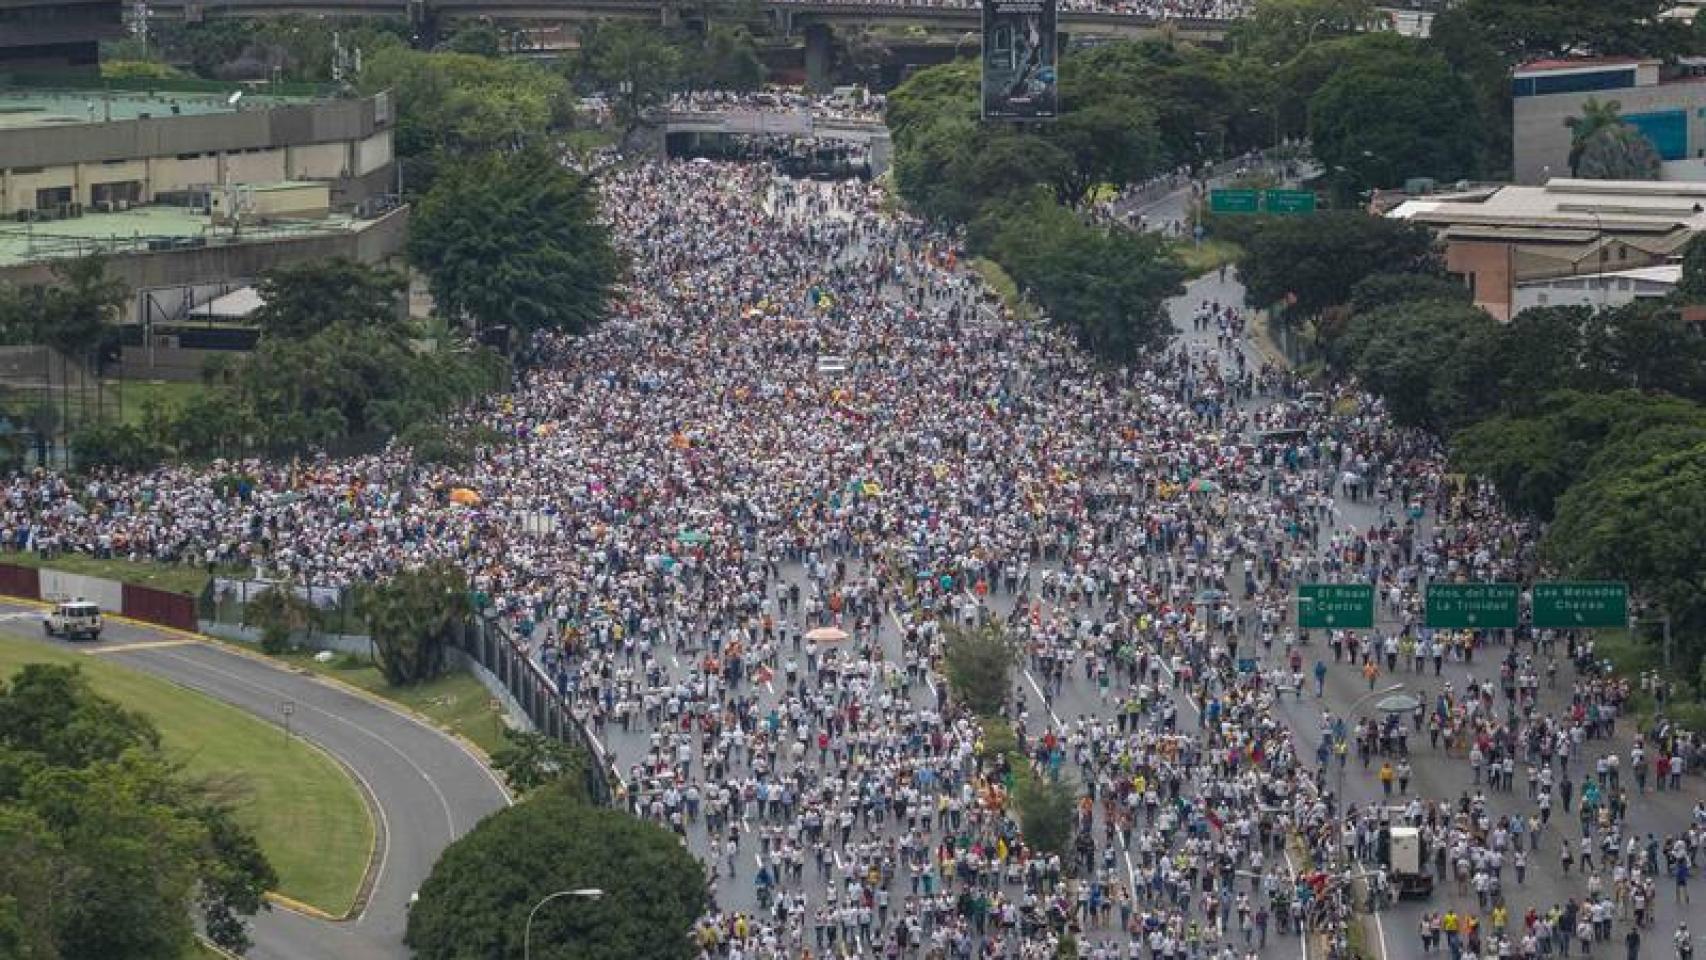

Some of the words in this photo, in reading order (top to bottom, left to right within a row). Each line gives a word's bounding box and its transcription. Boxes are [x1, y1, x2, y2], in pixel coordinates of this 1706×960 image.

[1317, 588, 1330, 598] El
[1564, 587, 1623, 597] Mercedes
[1318, 601, 1363, 611] Centro
[1457, 599, 1509, 611] Trinidad
